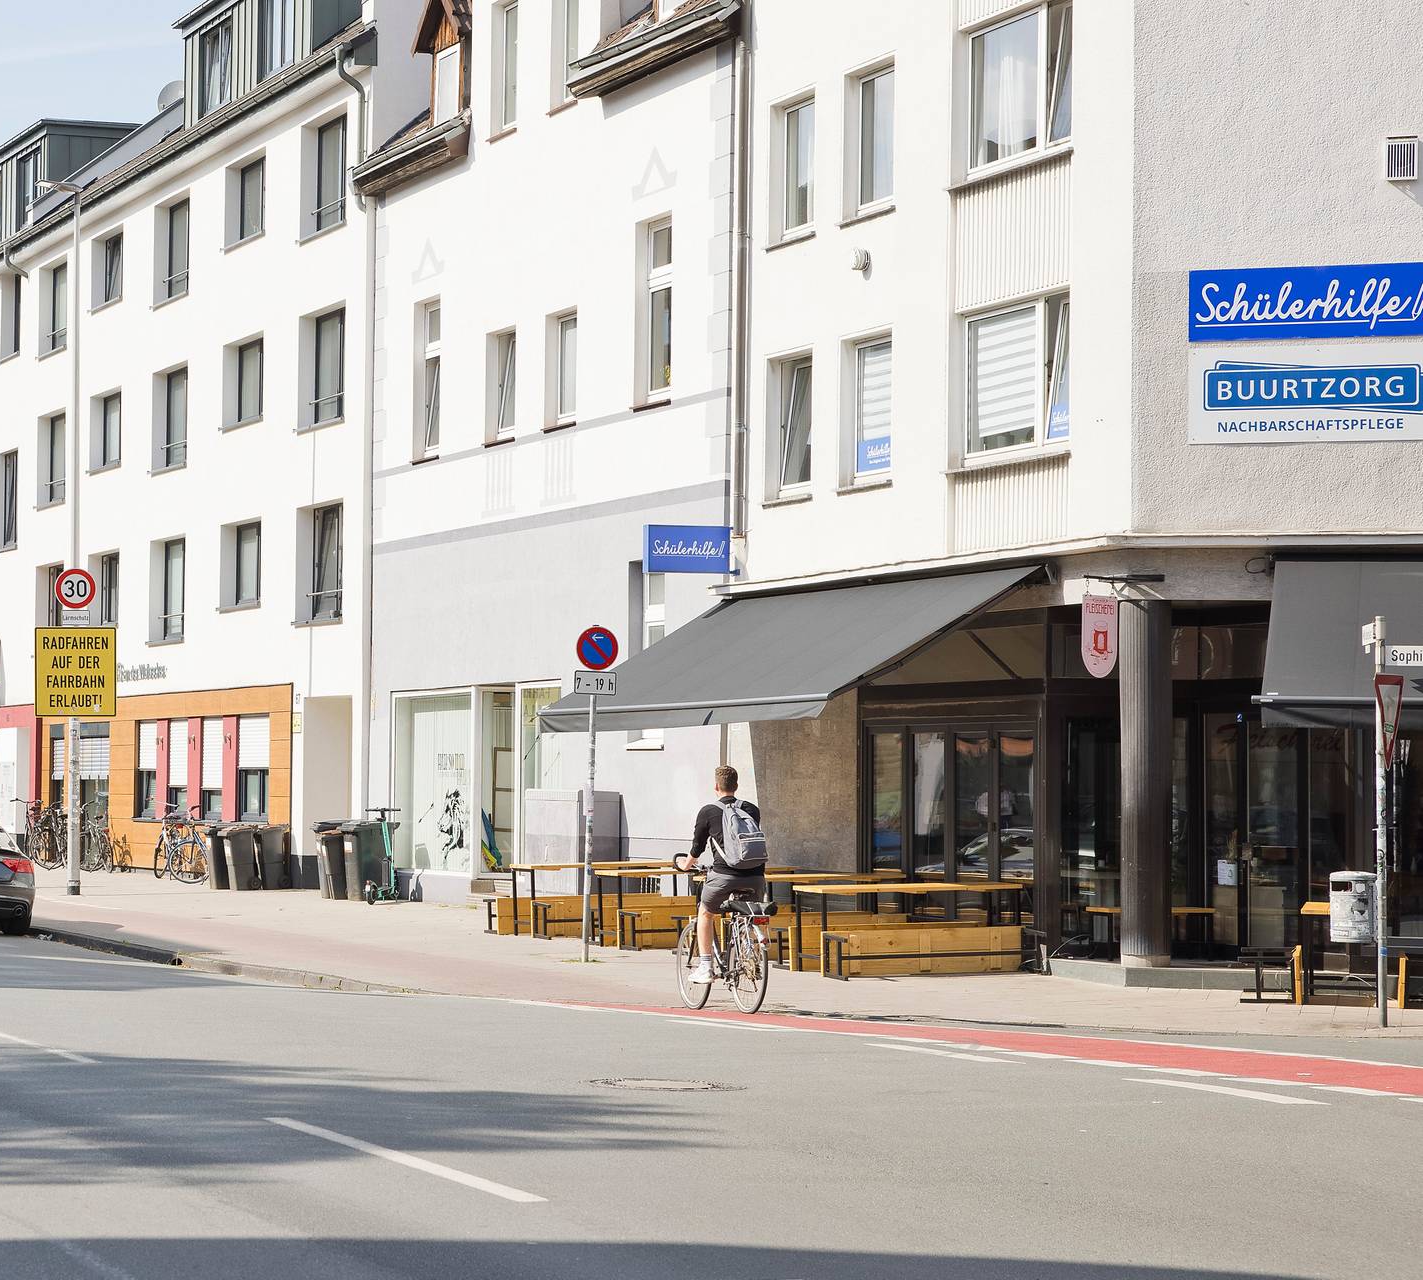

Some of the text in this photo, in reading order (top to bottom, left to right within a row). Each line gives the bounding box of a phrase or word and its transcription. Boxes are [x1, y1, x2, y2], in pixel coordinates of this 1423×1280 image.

[1216, 376, 1405, 401] BUURTZORG
[1217, 418, 1404, 433] NACHBARSCHAFTSPFLEGE
[64, 579, 88, 598] 30
[42, 636, 109, 650] RADFAHREN
[51, 655, 100, 669] AUF DER
[46, 675, 105, 689] FAHRBAHN
[576, 678, 582, 690] 7
[595, 678, 604, 691] 19
[608, 679, 614, 691] h
[49, 694, 103, 708] ERLAUBT!
